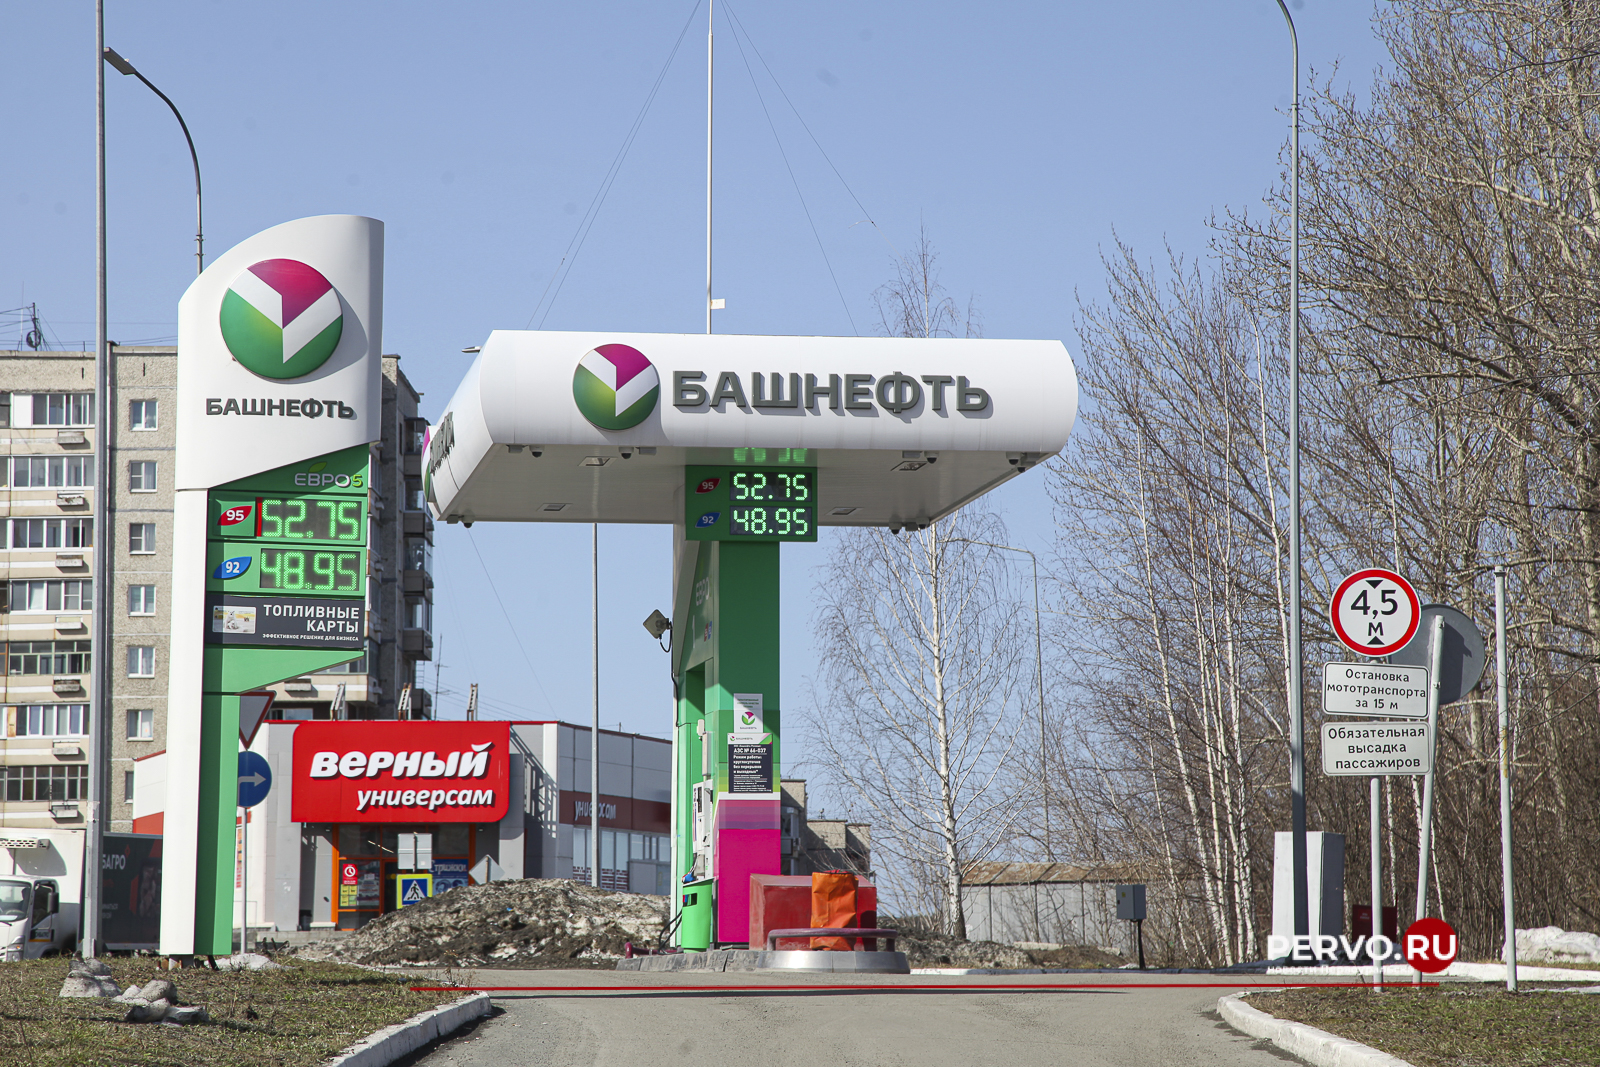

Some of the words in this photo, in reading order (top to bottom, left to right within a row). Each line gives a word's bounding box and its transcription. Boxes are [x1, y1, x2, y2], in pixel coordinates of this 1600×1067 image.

[672, 371, 989, 413] БАШНЕФТЬ
[206, 398, 354, 419] БАШНЕФТЬ
[702, 482, 714, 490] 95
[733, 473, 808, 500] 52.75
[226, 510, 244, 521] 95
[262, 499, 359, 540] 52.75
[702, 516, 714, 524] 92
[733, 507, 808, 535] 48.95
[225, 561, 240, 574] 92
[261, 552, 357, 591] 48.95
[263, 604, 360, 619] ТОПЛИВНЫЕ
[1350, 589, 1398, 619] 4,5
[306, 620, 359, 633] КАРТЫ
[1346, 668, 1410, 683] Остановка
[1327, 684, 1426, 699] мототранспорта
[1355, 699, 1368, 708] за
[1374, 698, 1385, 709] 15
[1390, 702, 1399, 710] м
[1328, 727, 1425, 740] Обязательная
[1348, 743, 1407, 754] высадка
[1336, 758, 1421, 770] пассажиров
[356, 789, 493, 811] универсам
[574, 800, 617, 821] унивсам
